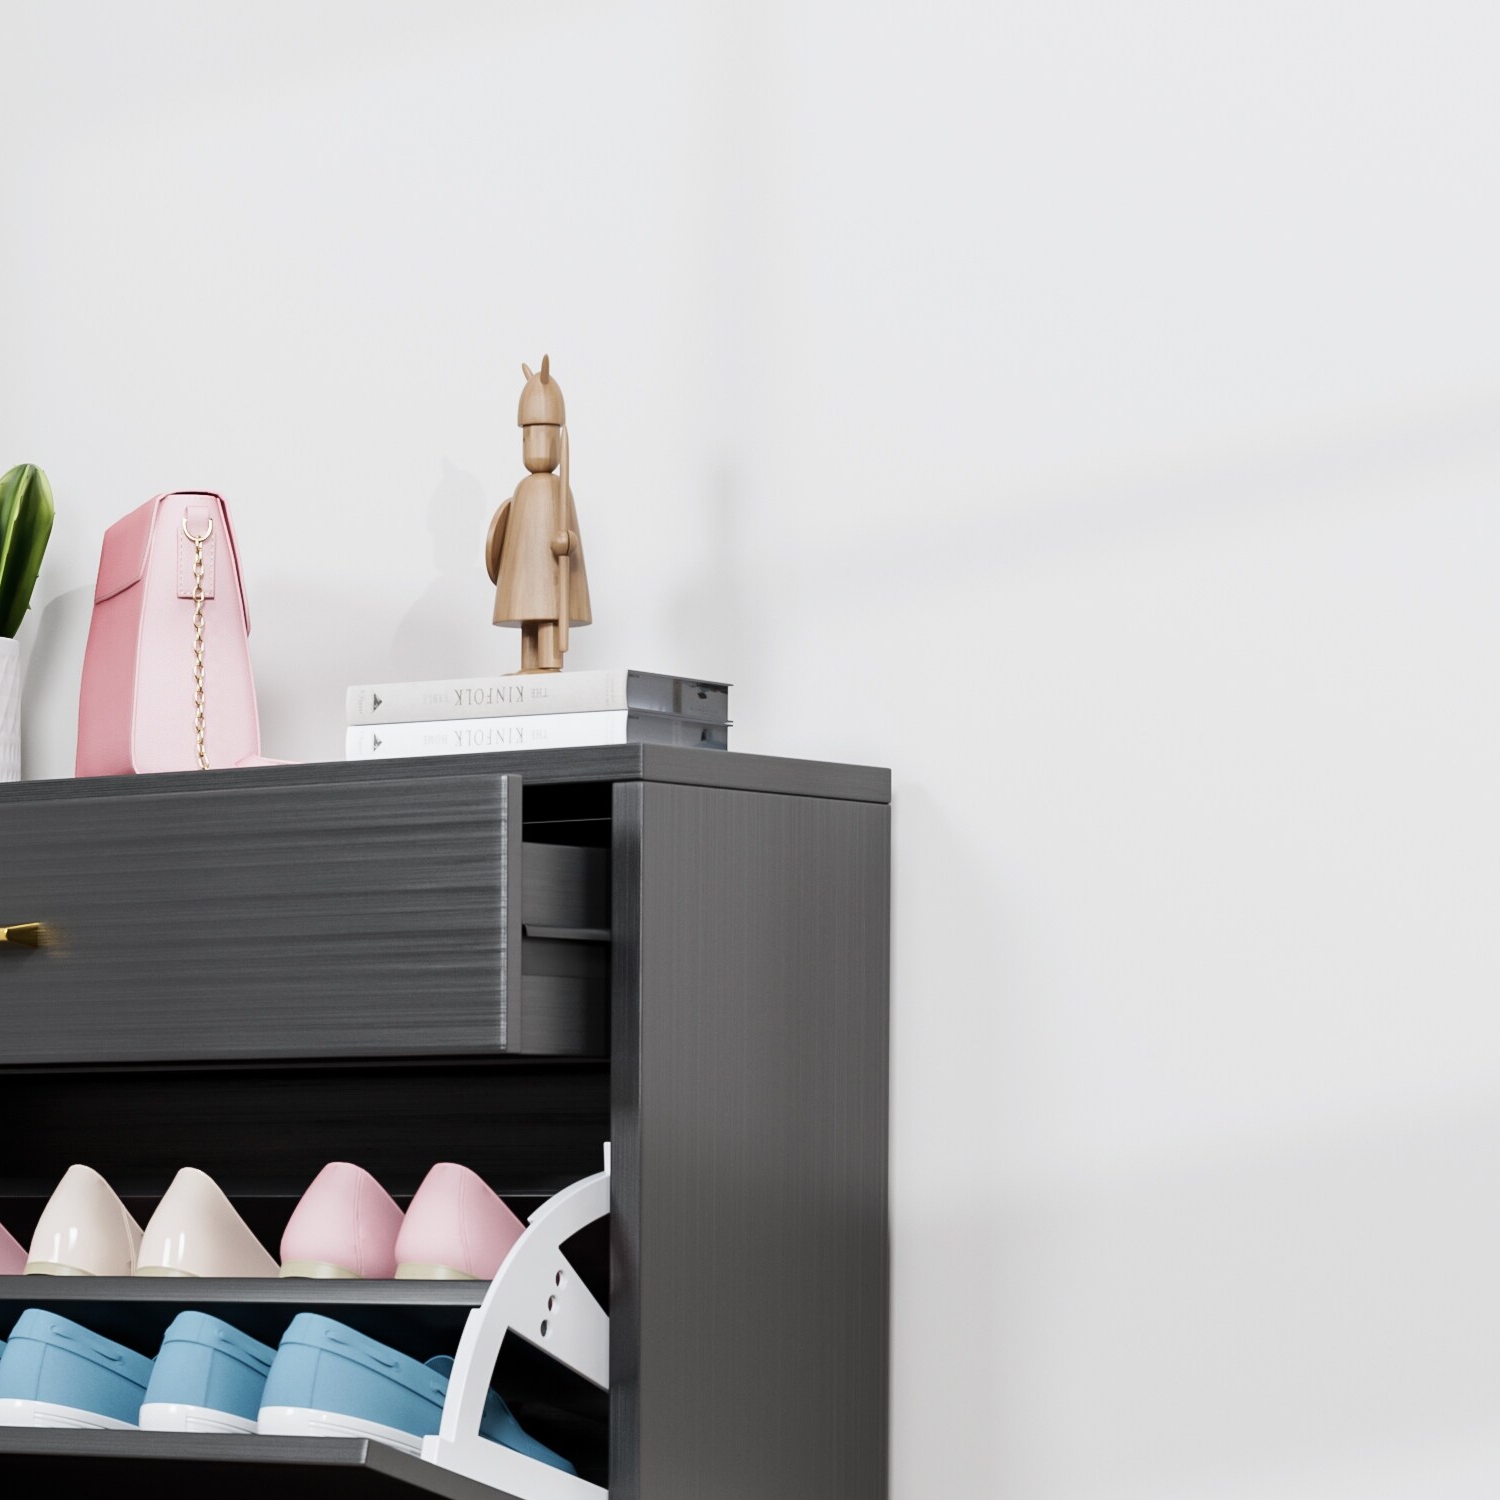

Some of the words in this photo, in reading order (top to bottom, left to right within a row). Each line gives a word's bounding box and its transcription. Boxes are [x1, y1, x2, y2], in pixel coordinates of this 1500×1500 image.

[454, 685, 524, 706] KINFOLK
[531, 687, 549, 698] THE
[422, 734, 449, 745] HOME
[454, 727, 524, 747] KINFOLK
[531, 729, 549, 740] THE
